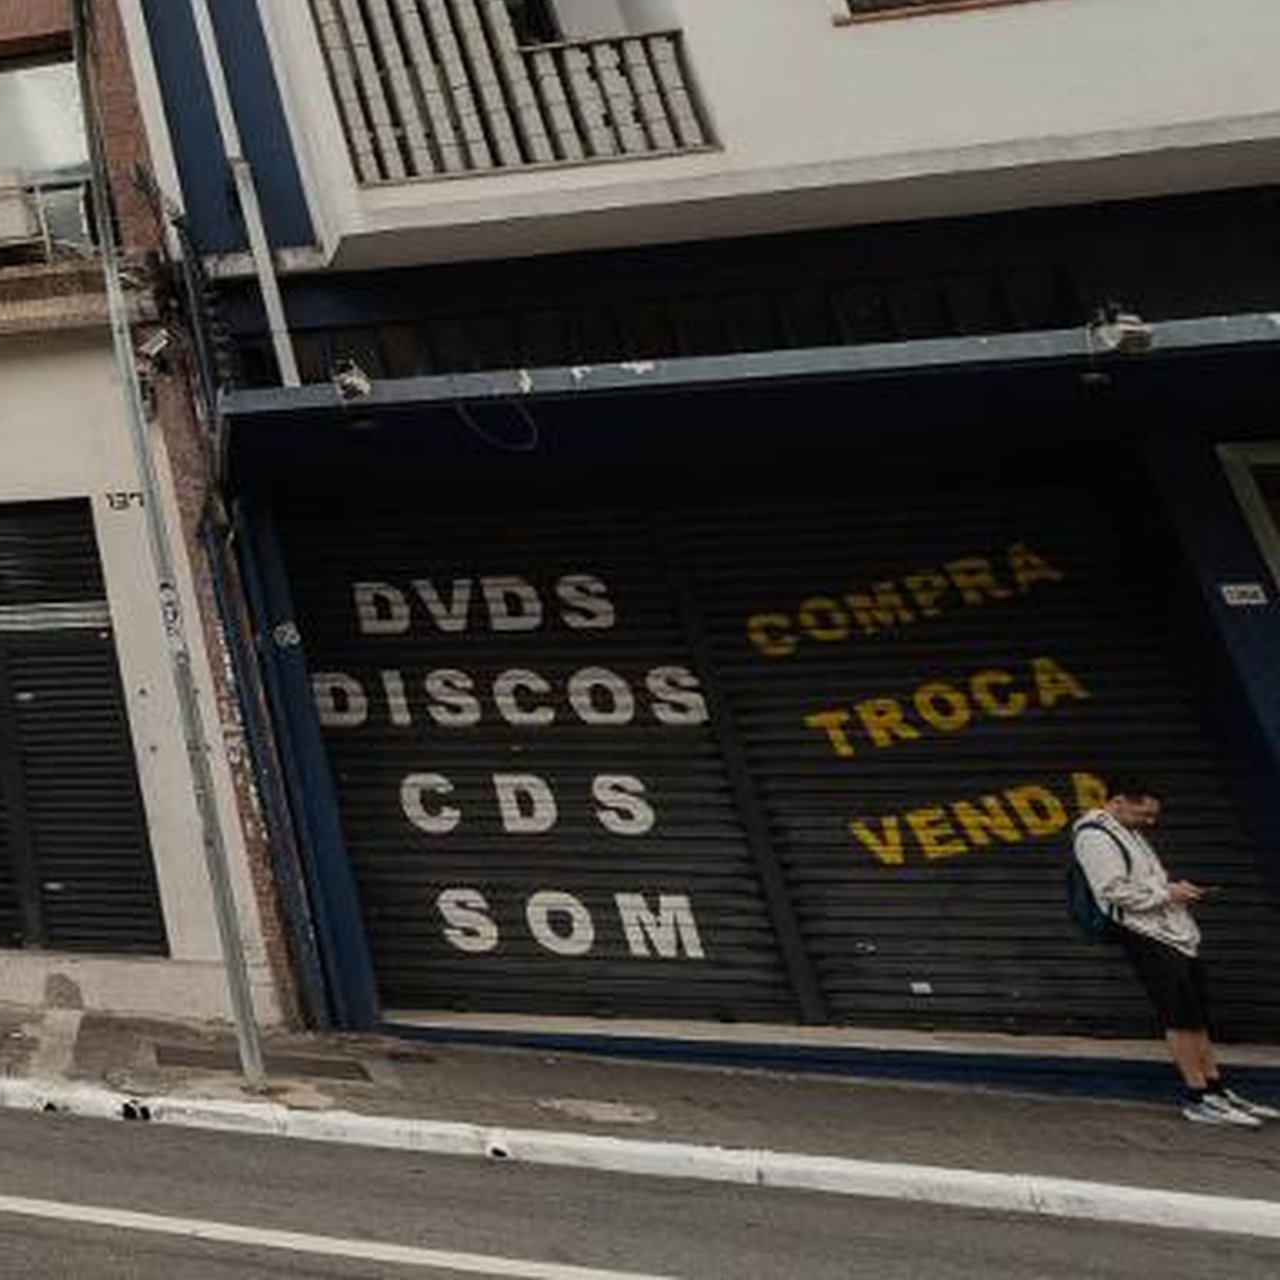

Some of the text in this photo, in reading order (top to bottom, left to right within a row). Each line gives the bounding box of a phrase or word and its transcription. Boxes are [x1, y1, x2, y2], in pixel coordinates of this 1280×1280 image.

[352, 574, 617, 634] DVDS
[746, 544, 1065, 657] COMPRA
[312, 666, 710, 726] DISCOS
[804, 656, 1092, 758] TROCA
[436, 888, 706, 960] SOM
